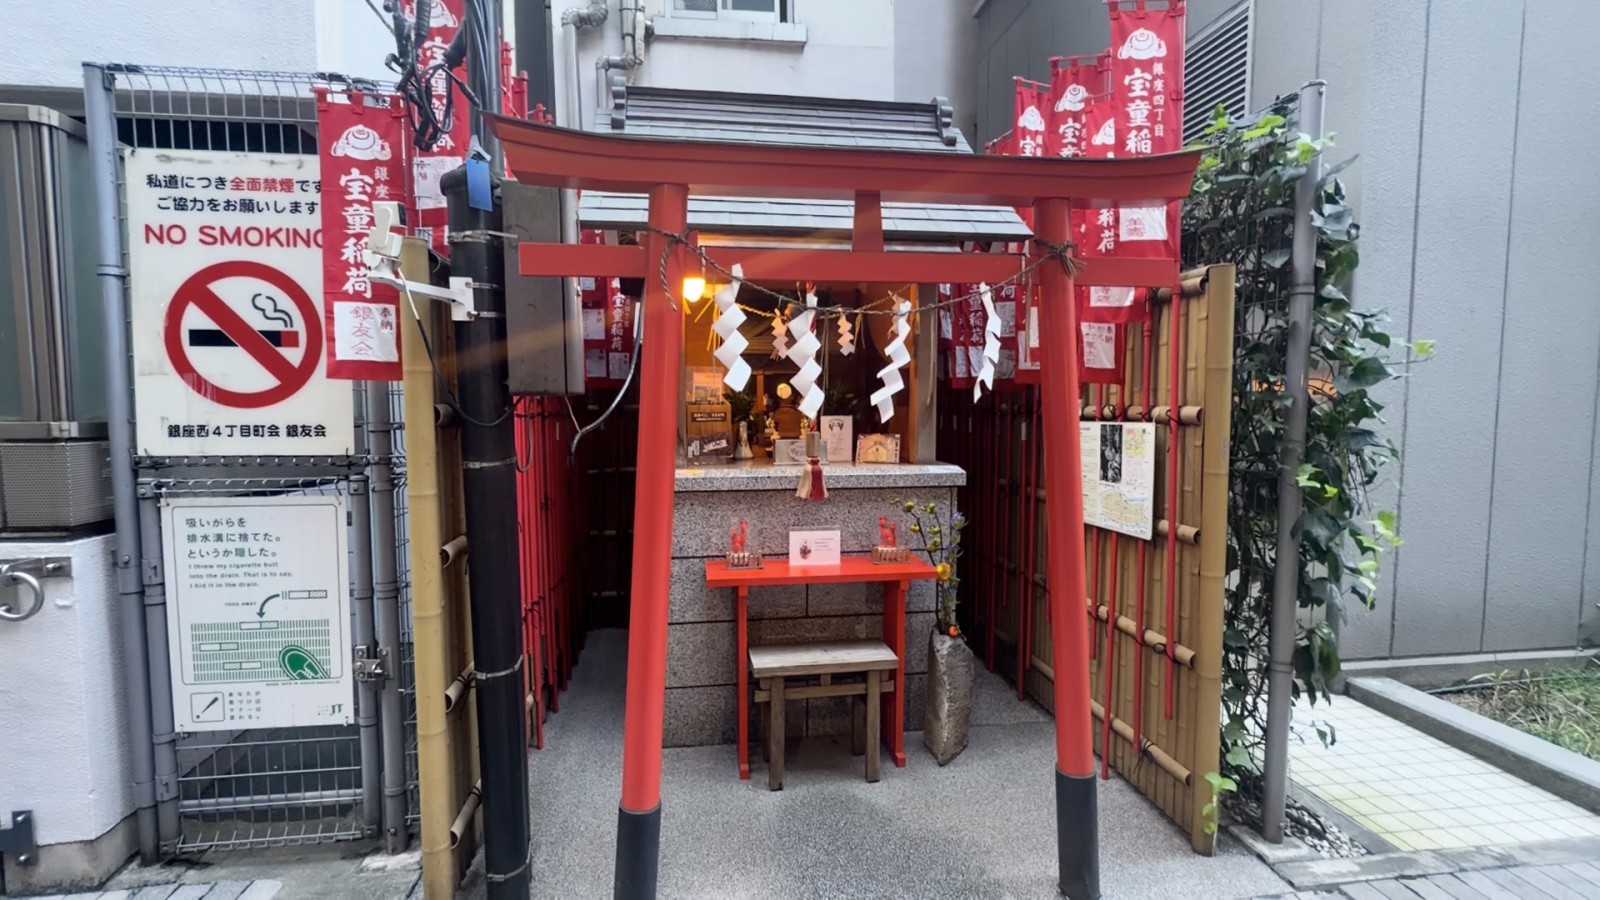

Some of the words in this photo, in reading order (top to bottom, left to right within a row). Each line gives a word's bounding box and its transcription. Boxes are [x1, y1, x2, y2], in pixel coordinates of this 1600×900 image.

[1152, 62, 1165, 137] 銀座四丁目
[374, 166, 390, 199] 銀座
[157, 197, 319, 215] ご協力をお願いします
[144, 224, 187, 245] NO
[350, 305, 375, 356] 銀友会
[286, 424, 327, 437] 銀友会
[185, 517, 247, 528] 吸いがらを
[187, 532, 281, 543] 排水溝に捨てた。
[187, 547, 277, 558] というか隠した。
[330, 703, 344, 716] JT
